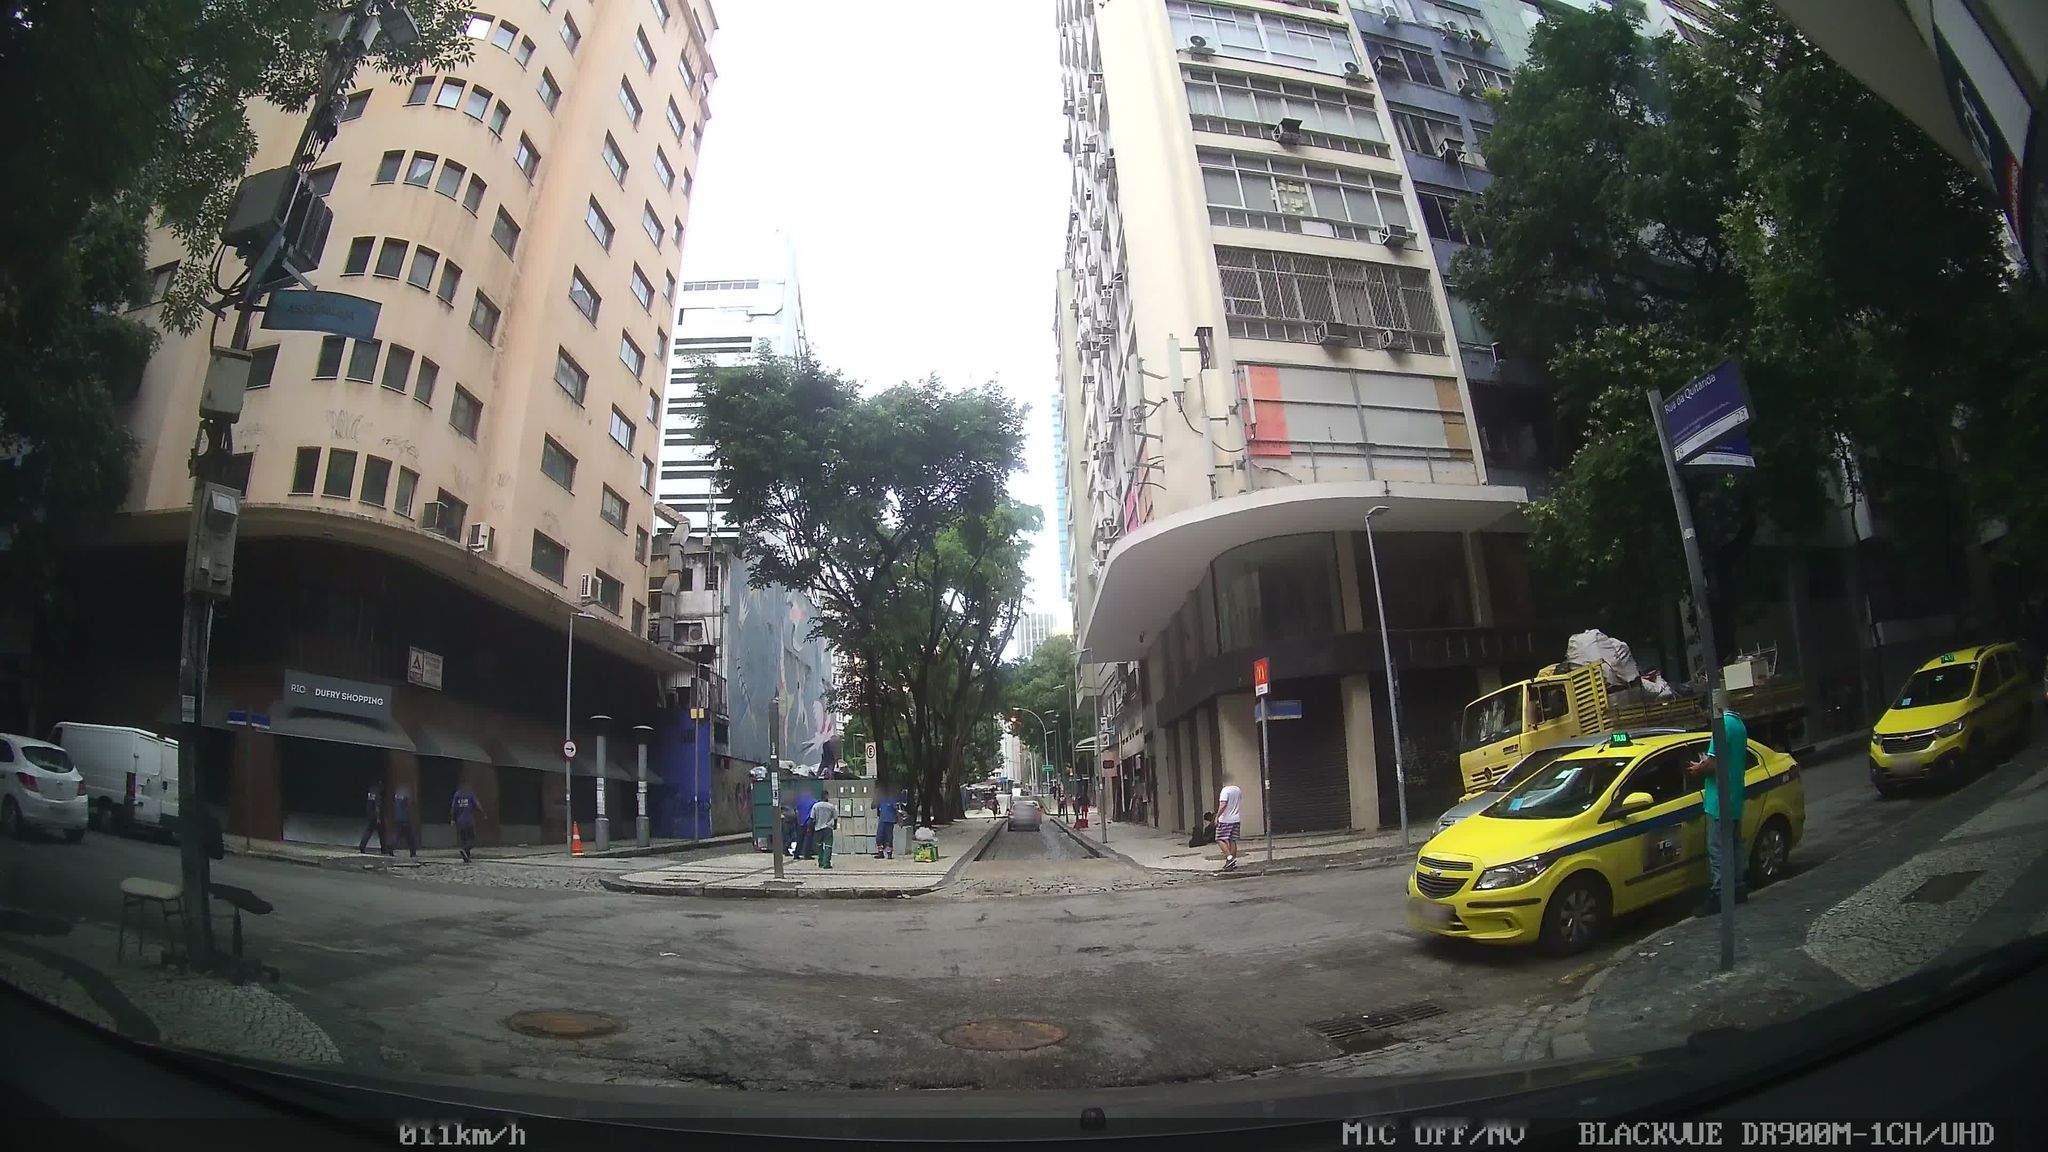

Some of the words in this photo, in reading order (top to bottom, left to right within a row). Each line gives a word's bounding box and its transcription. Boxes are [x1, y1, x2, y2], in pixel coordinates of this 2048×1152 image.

[1664, 404, 1677, 415] Rua
[1676, 395, 1685, 405] da
[1684, 374, 1716, 399] Quitanda
[290, 683, 306, 695] RIO
[315, 688, 340, 700] DUFRY
[341, 692, 384, 706] SHOPPING
